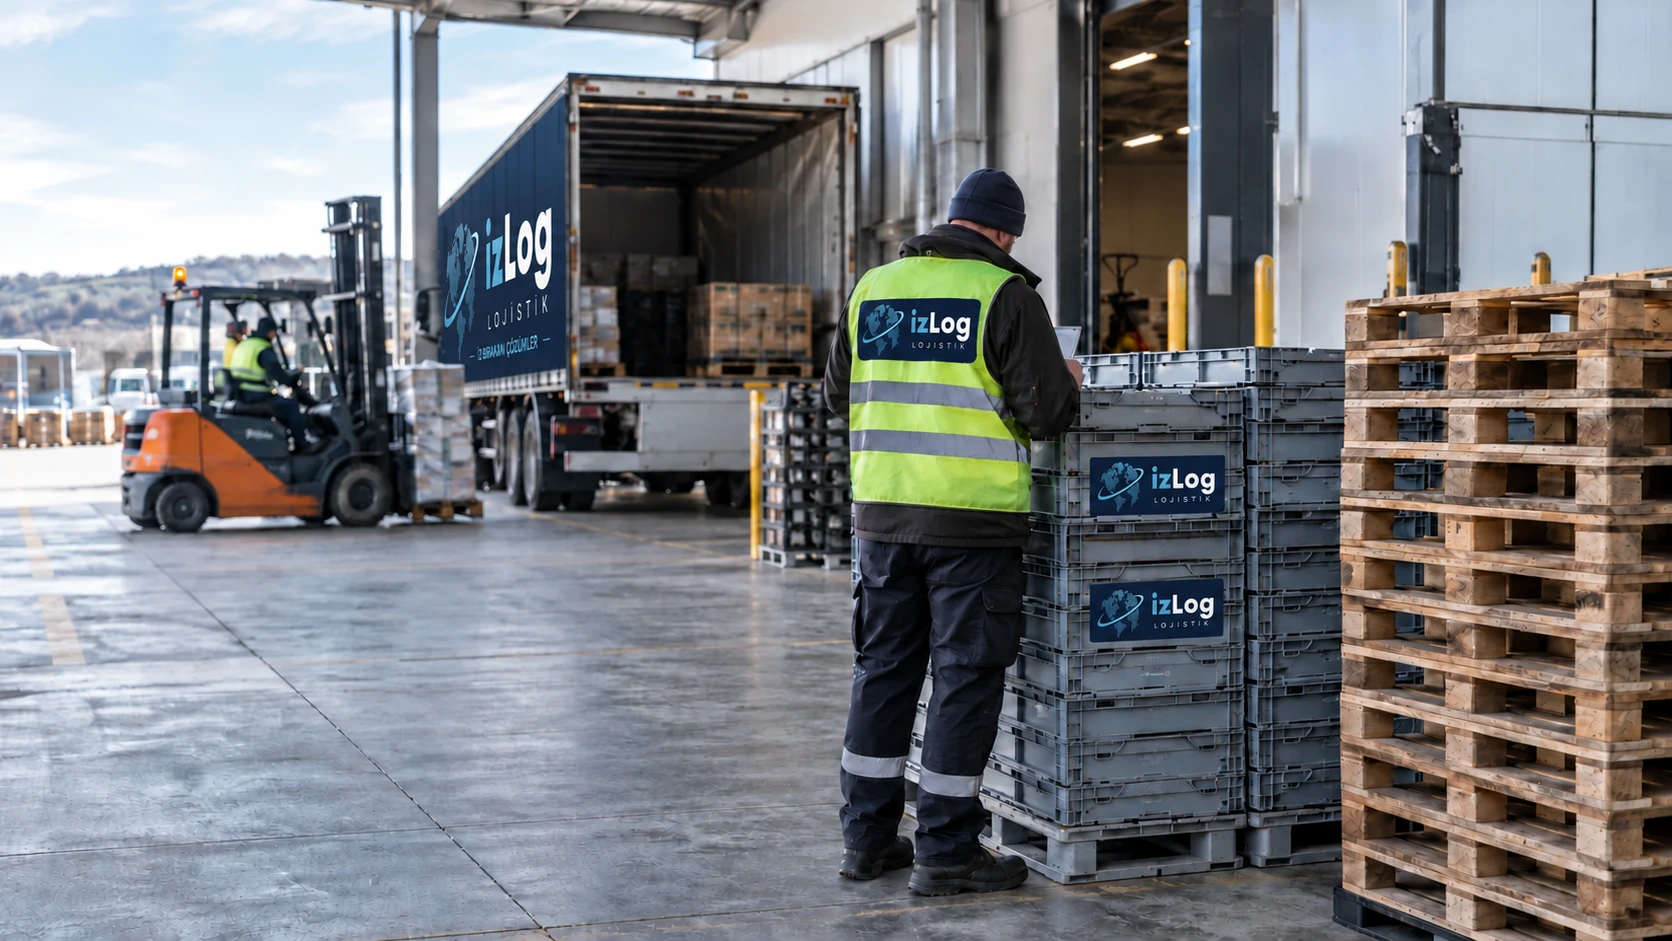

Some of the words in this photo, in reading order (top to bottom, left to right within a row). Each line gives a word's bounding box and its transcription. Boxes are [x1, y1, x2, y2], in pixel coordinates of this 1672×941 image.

[485, 207, 553, 290] izLog
[487, 294, 548, 331] LOJİSTİK
[910, 308, 971, 342] izLog
[1151, 465, 1216, 495] izLog
[1151, 591, 1214, 620] izLog
